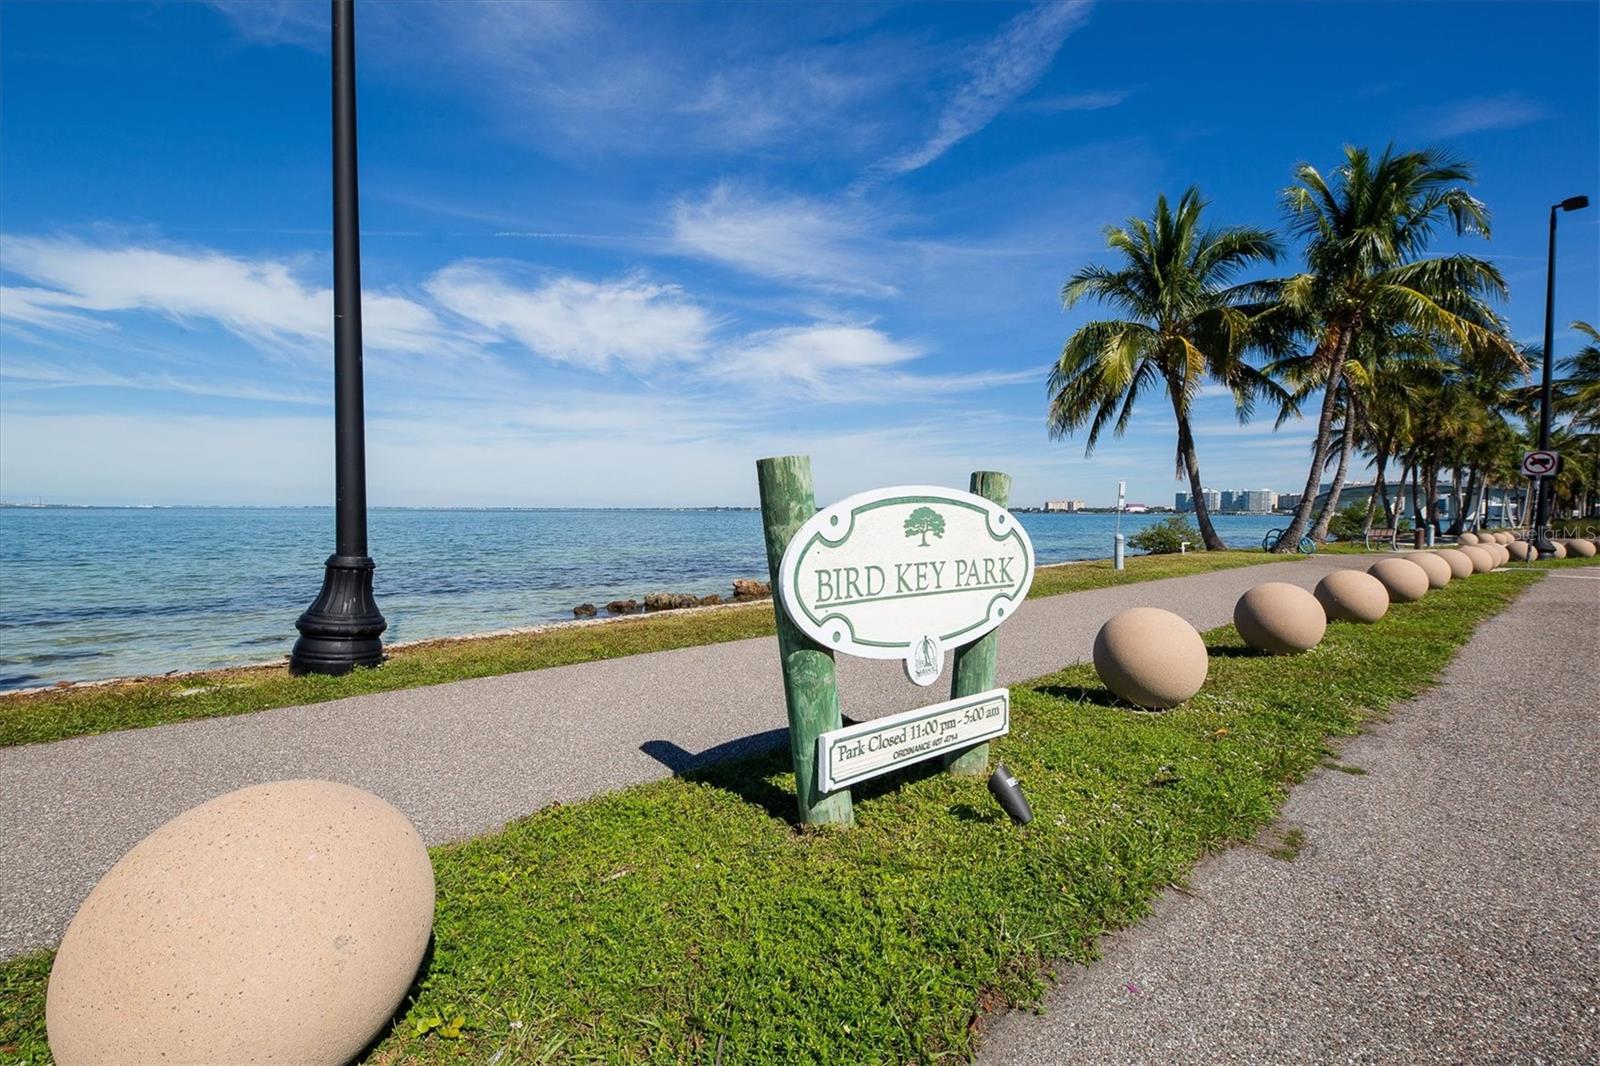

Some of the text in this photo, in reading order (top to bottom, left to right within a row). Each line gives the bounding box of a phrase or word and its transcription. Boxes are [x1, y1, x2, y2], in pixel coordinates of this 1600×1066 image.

[814, 556, 1015, 603] BIRD KEY PARK
[838, 741, 864, 761] Park
[868, 727, 907, 752] Closed
[910, 720, 939, 741] 11:00
[940, 716, 956, 736] pm
[963, 706, 985, 725] 5:00
[985, 706, 1000, 719] am
[892, 741, 931, 760] ORDINANCE
